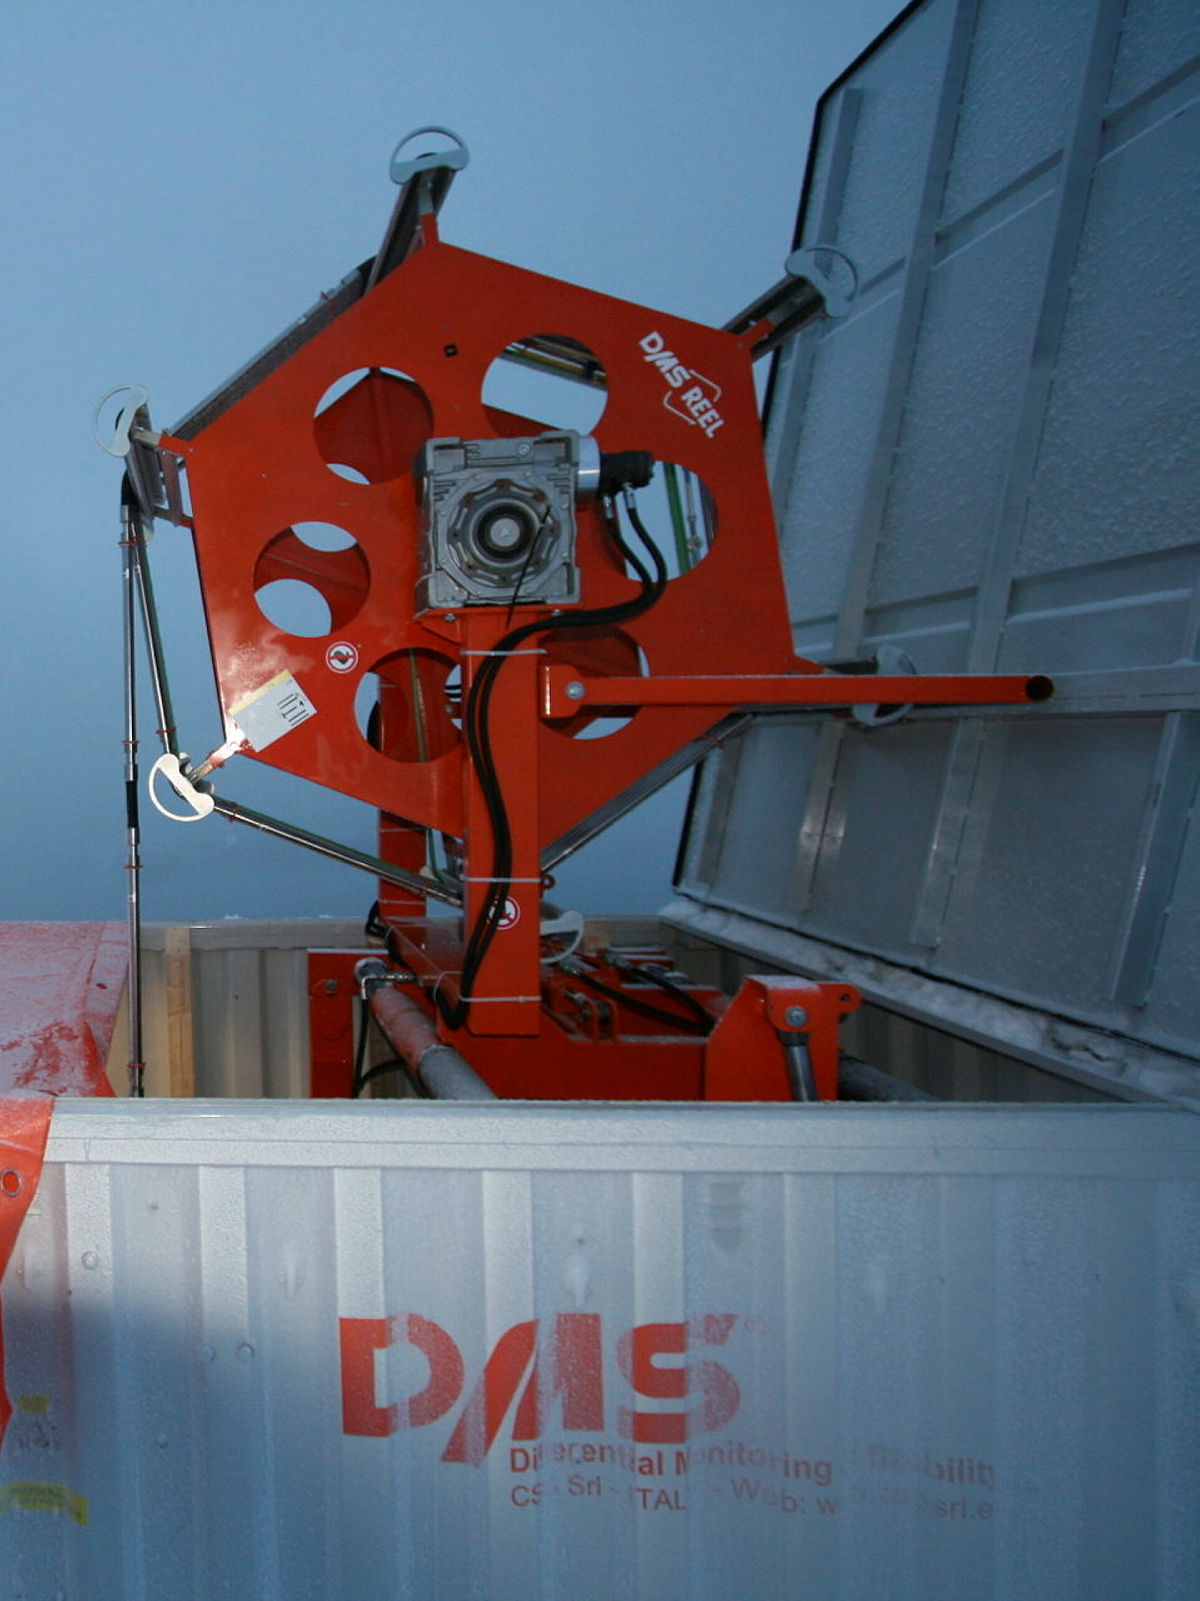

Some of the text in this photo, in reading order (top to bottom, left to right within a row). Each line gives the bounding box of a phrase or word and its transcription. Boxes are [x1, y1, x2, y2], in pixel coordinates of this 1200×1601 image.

[639, 331, 724, 438] DMS REEL
[339, 1312, 741, 1464] DMS
[675, 1439, 832, 1487] Mnitoring
